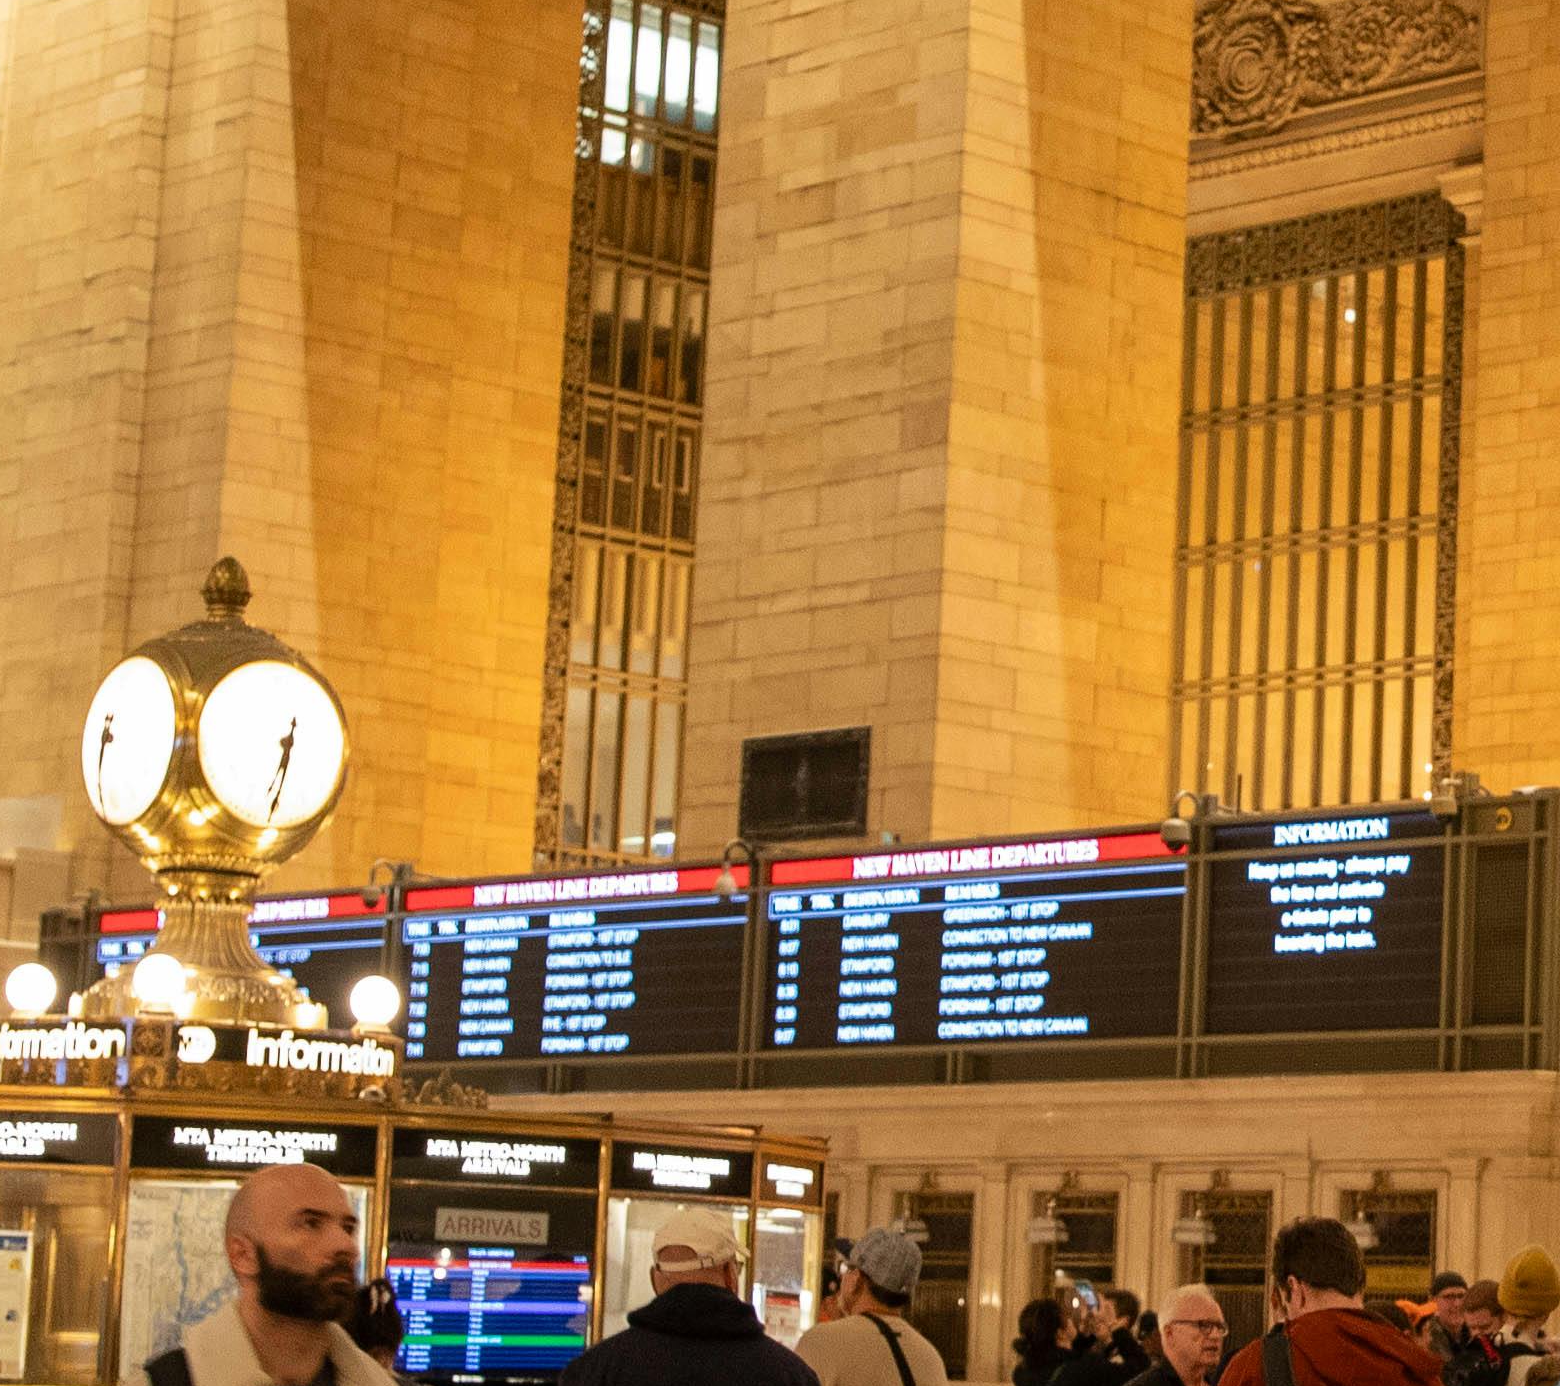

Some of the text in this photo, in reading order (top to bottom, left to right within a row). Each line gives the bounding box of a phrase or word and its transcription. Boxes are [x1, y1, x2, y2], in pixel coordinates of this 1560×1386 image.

[1274, 818, 1389, 845] INFORMATION
[853, 839, 1098, 879] NEW HAVEN LINE DEPARTURES
[473, 884, 505, 907] NEW
[589, 871, 679, 897] DEPARTURES
[842, 937, 864, 951] NEW
[246, 1028, 395, 1077] Information
[174, 1127, 337, 1152] MTA METRO-NORTH
[427, 1139, 566, 1163] MTA METRO-NORTH
[462, 1158, 530, 1177] ARRIVALS
[442, 1215, 541, 1239] ARRIVALS
